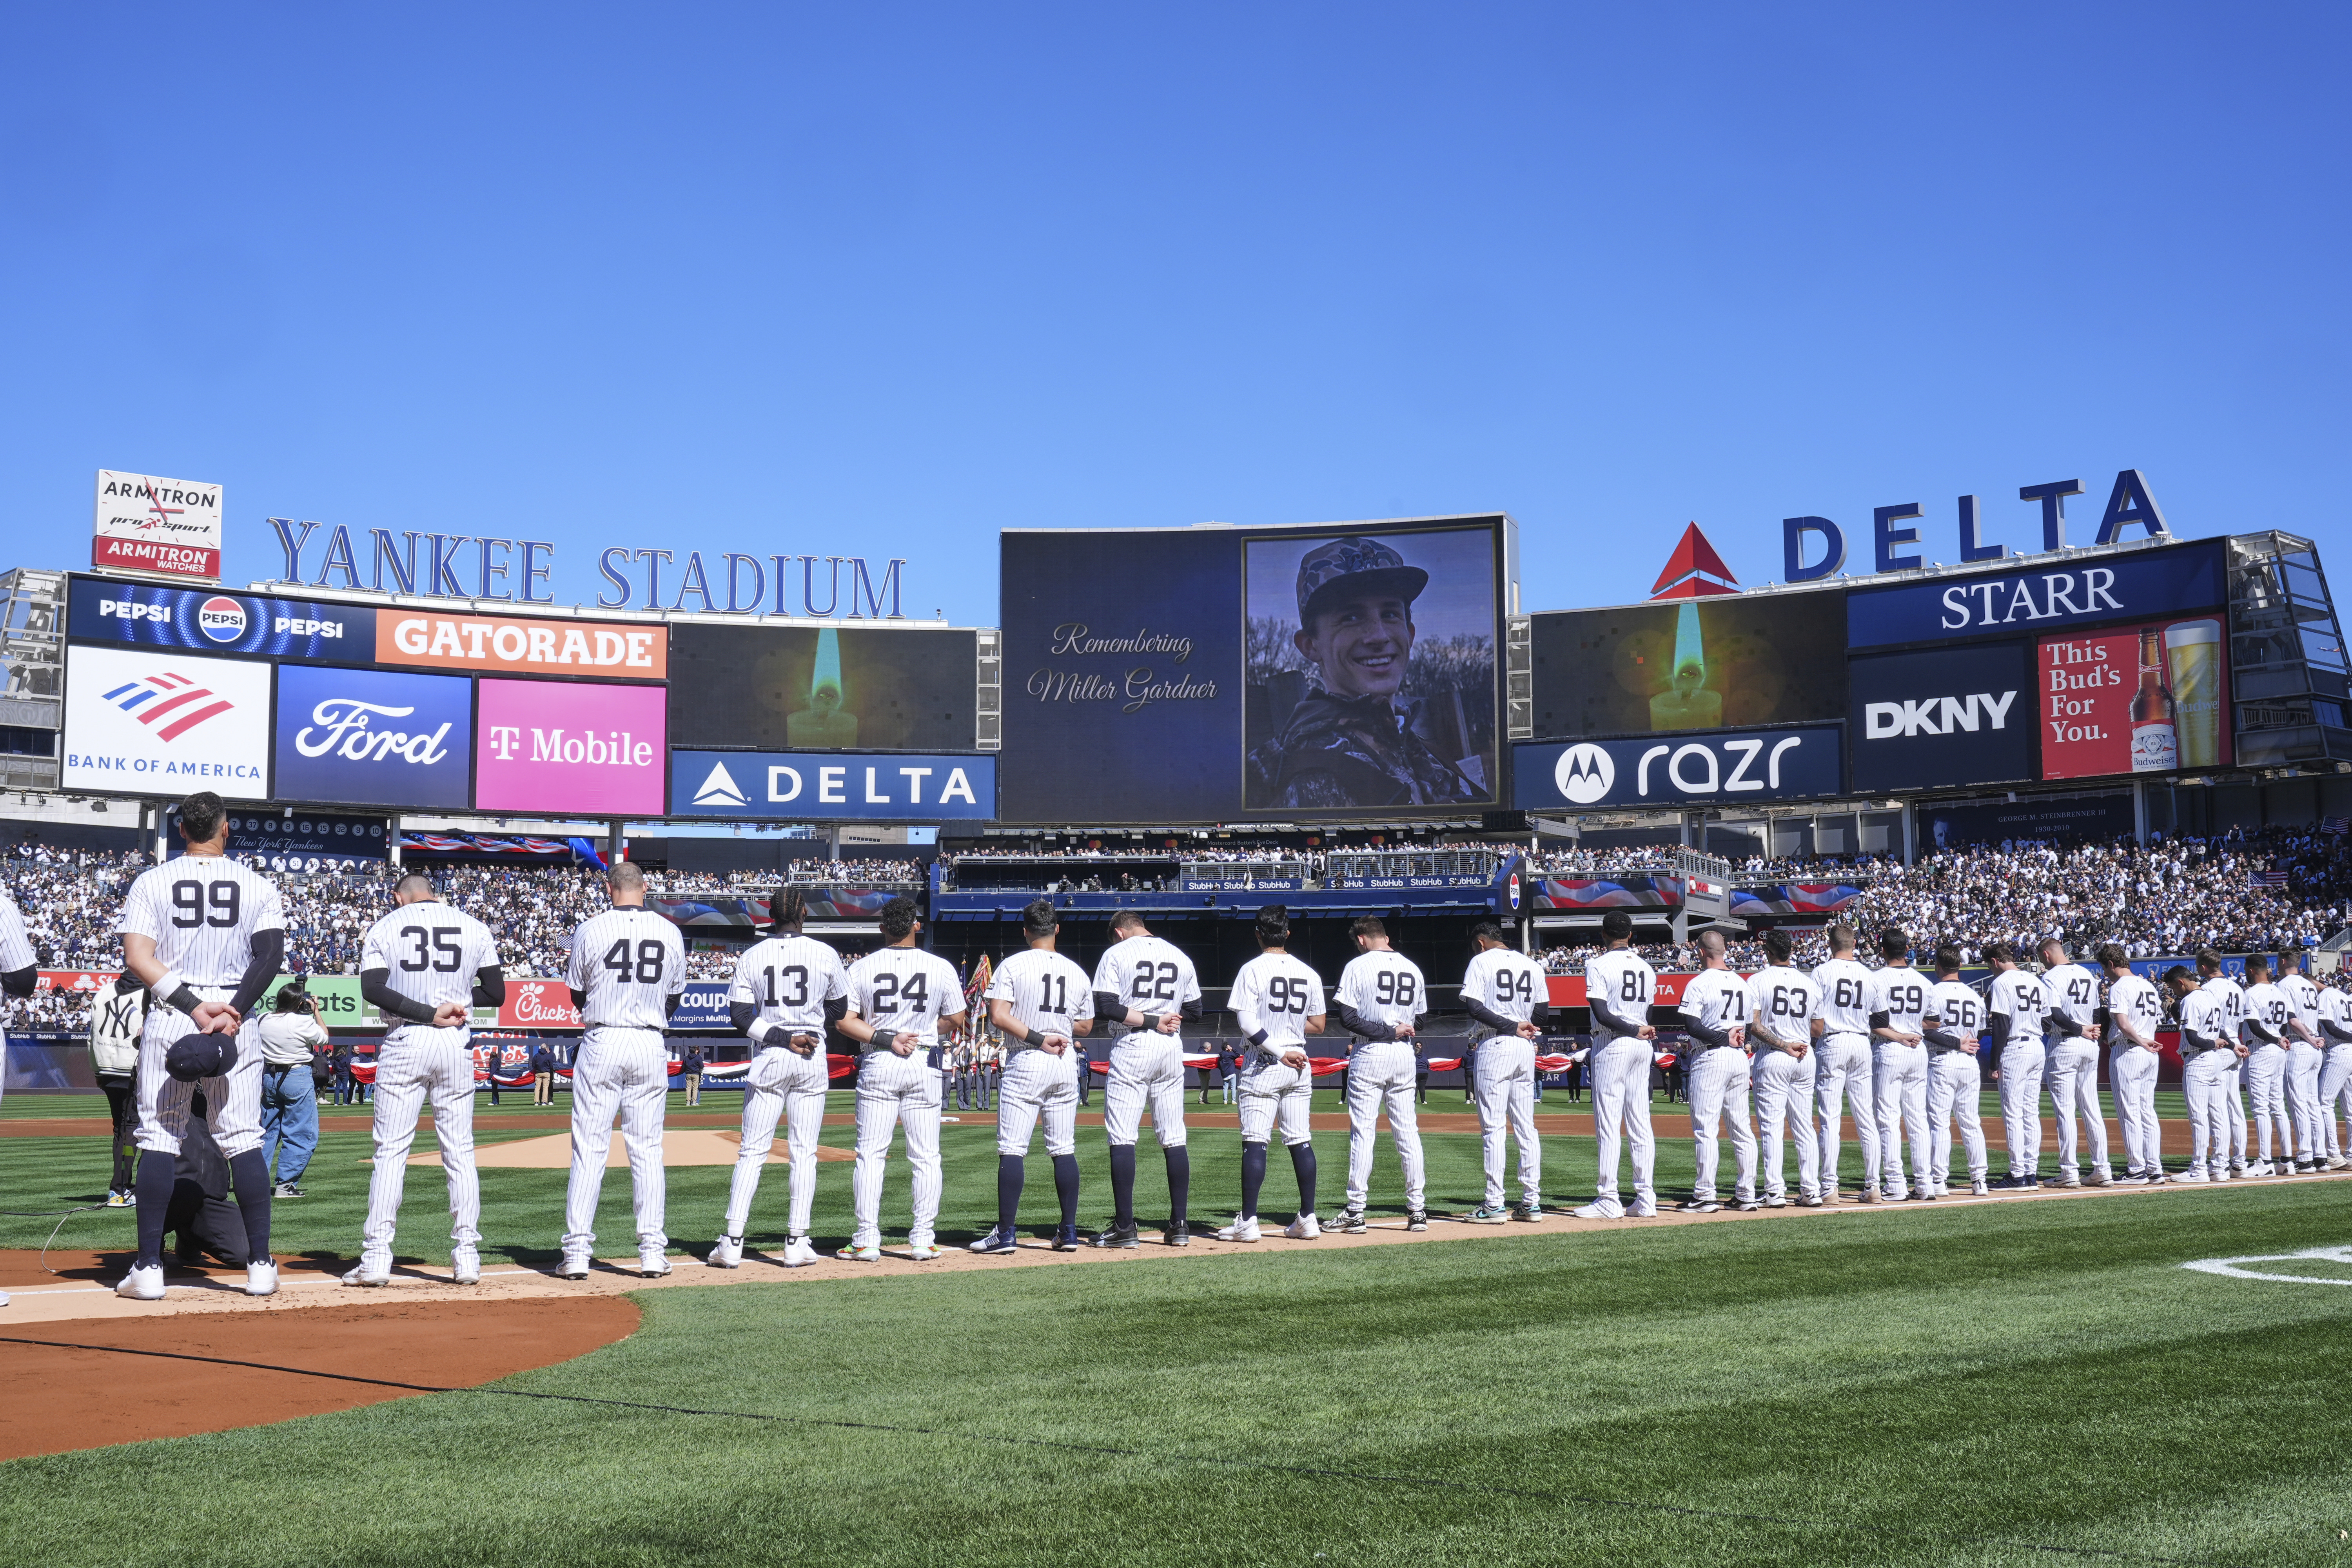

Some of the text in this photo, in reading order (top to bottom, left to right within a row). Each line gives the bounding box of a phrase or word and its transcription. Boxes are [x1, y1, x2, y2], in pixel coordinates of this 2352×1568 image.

[104, 482, 215, 508] ARMITRON
[162, 522, 210, 532] sport
[1783, 469, 2172, 583] DELTA
[107, 542, 208, 564] ARMITRON
[157, 560, 205, 573] WATCHES
[266, 517, 906, 618] YANKEE STADIUM
[100, 600, 170, 622] PEPSI
[1942, 568, 2123, 629] STARR
[203, 613, 243, 625] PEPSI
[275, 617, 343, 638] PEPSI
[394, 619, 652, 667] GATORADE
[1051, 623, 1193, 663] Remembering
[2047, 640, 2107, 665] This
[1027, 668, 1217, 713] Miller Gardner
[2049, 664, 2121, 691] Bud's
[1866, 691, 2017, 739] DKNY
[2050, 695, 2094, 717] For
[295, 699, 452, 764] Ford
[2050, 720, 2108, 742] You.
[490, 726, 652, 766] T Mobile
[68, 754, 260, 779] BANK OF AMERICA
[1638, 737, 1801, 796] razr
[2134, 756, 2174, 766] Budweiser
[768, 766, 976, 804] DELTA
[2041, 810, 2096, 819] STEINBRENNER
[233, 835, 323, 854] New York Yankees
[1371, 879, 1403, 887] StubHub
[1410, 878, 1442, 886] StubHub
[1510, 886, 1519, 895] PEPSI
[172, 880, 240, 928] 99
[400, 926, 461, 972] 35
[603, 939, 665, 984] 48
[764, 965, 808, 1007] 13
[873, 973, 928, 1013] 24
[1039, 973, 1065, 1014] 11
[1132, 960, 1178, 1000] 22
[1376, 971, 1415, 1006] 98
[1496, 969, 1532, 1002] 94
[1621, 970, 1646, 1002] 81
[1835, 978, 1862, 1009] 61
[2067, 978, 2091, 1004] 47
[318, 993, 356, 1012] ats
[680, 993, 730, 1013] coup
[1269, 976, 1308, 1014] 95
[1720, 990, 1744, 1021] 71
[1772, 985, 1808, 1018] 63
[1890, 986, 1921, 1014] 59
[2015, 985, 2042, 1013] 54
[2136, 991, 2156, 1016] 45
[2226, 992, 2239, 1016] 41
[2301, 987, 2318, 1010] 33
[674, 1015, 704, 1024] Margins
[1945, 999, 1976, 1027] 56
[2205, 1008, 2220, 1032] 43
[2265, 1001, 2285, 1024] 38
